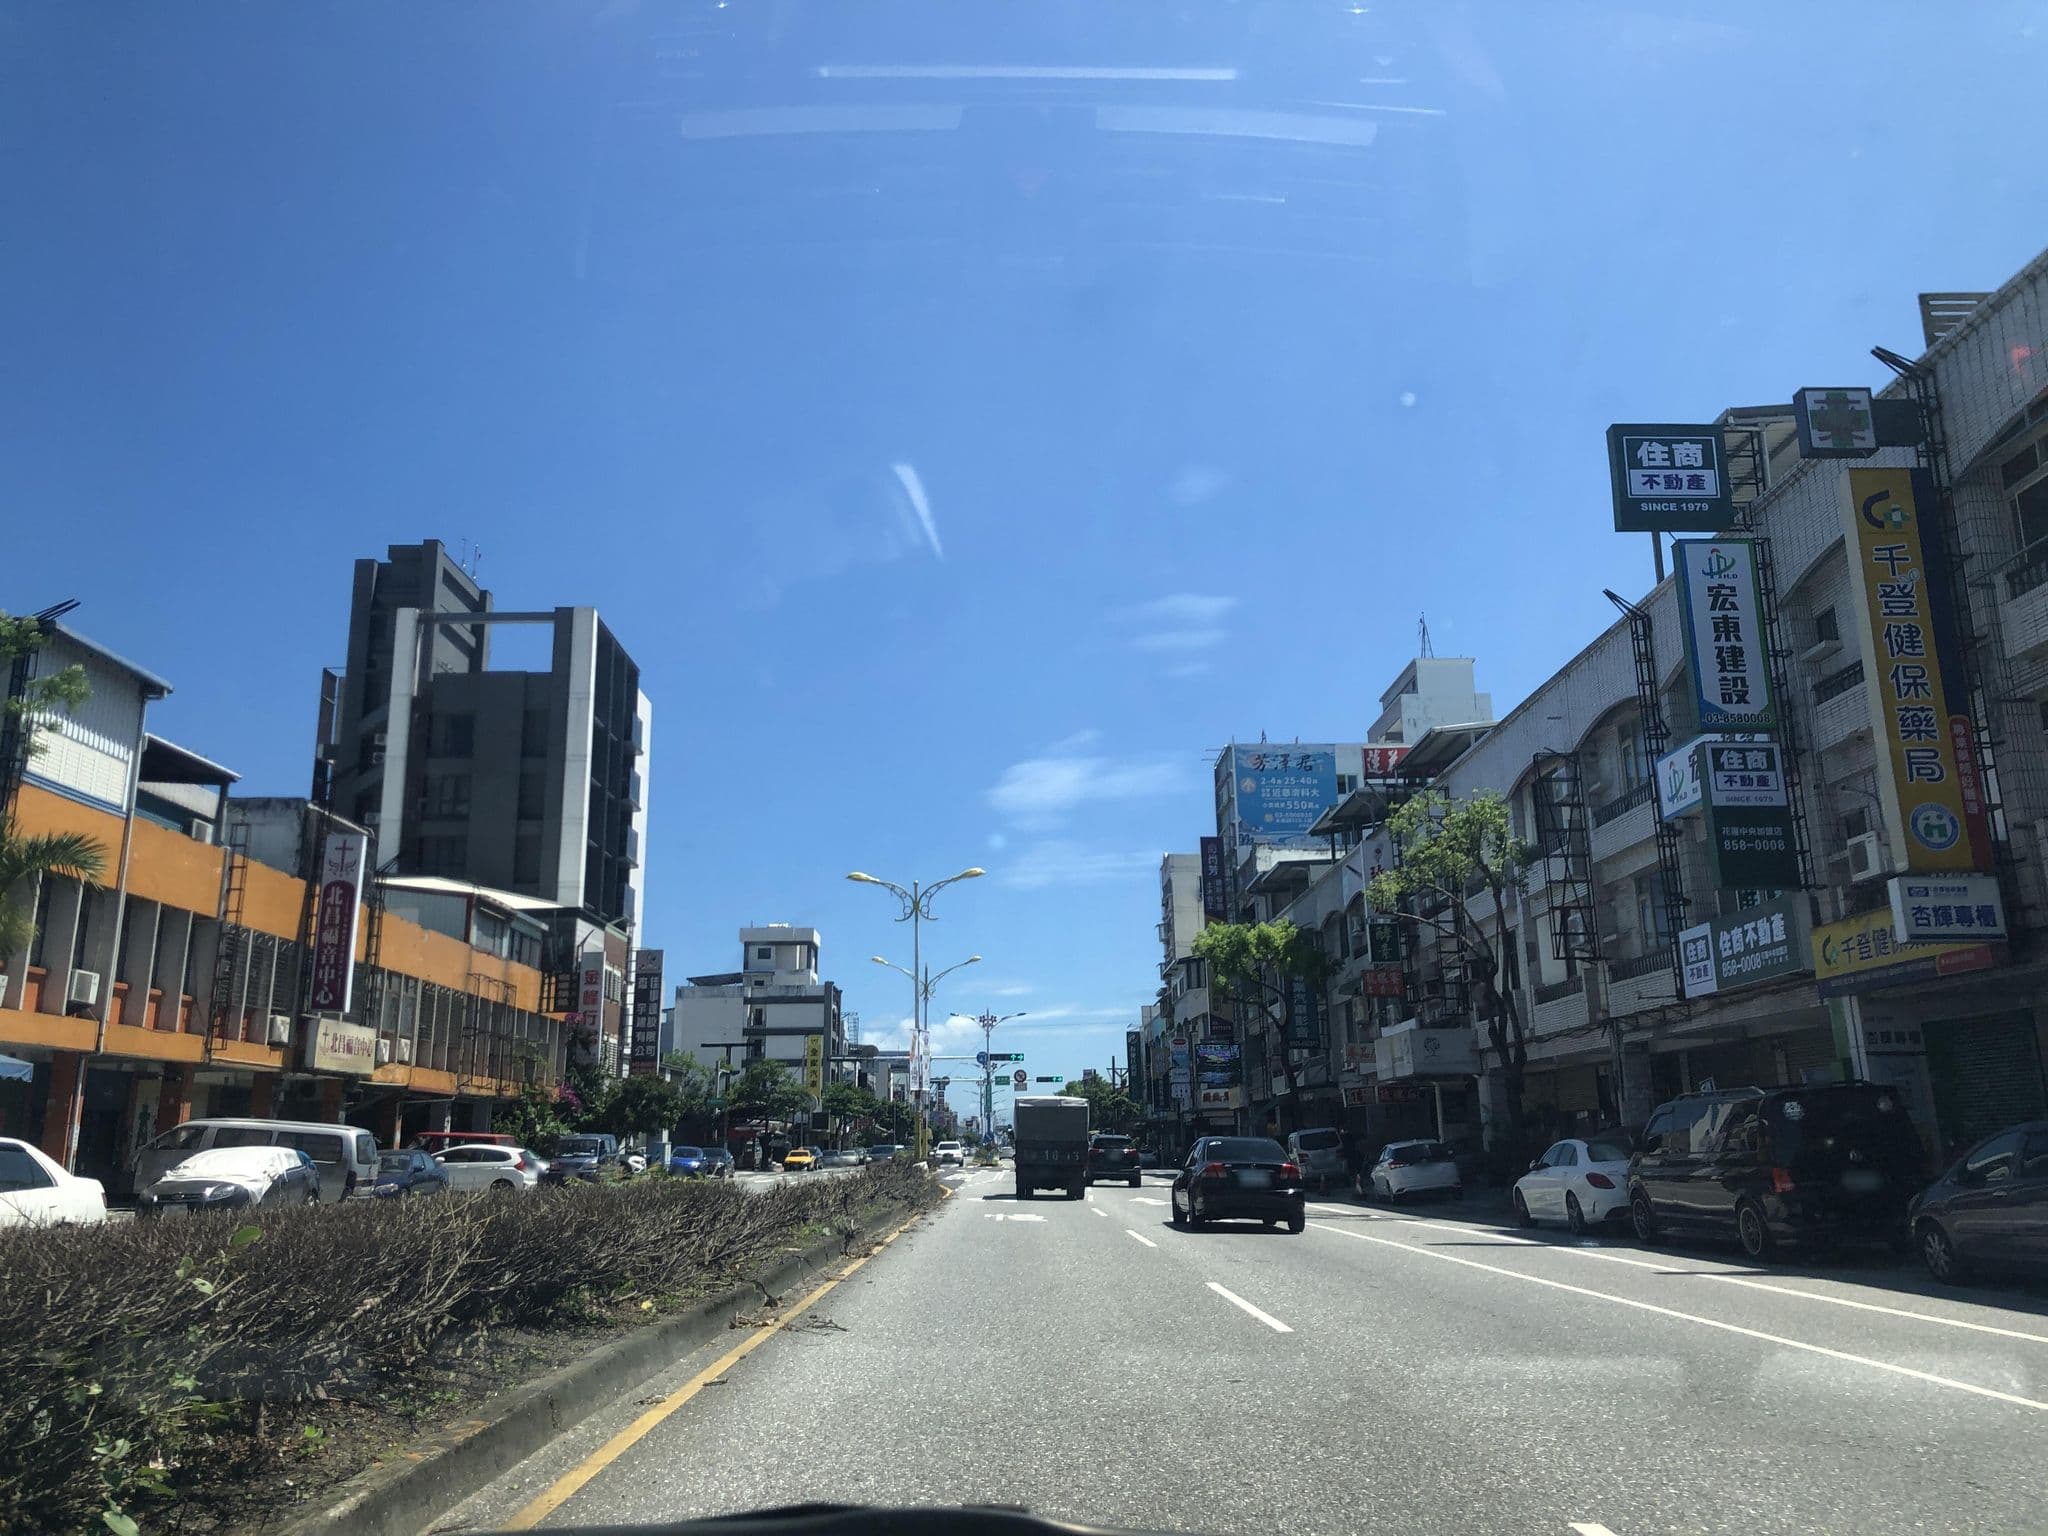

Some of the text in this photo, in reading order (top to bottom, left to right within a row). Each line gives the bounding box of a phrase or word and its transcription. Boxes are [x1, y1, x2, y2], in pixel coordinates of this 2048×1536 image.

[1637, 441, 1703, 468] 住商
[1641, 474, 1706, 491] 不動產
[1640, 502, 1709, 512] SINCE 1979
[1707, 583, 1751, 705] 宏東建設
[1873, 543, 1945, 784] 千登健保藥局
[1706, 712, 1771, 724] 03-8580008
[1720, 749, 1768, 770] 住商
[1723, 774, 1770, 787] 不動產
[1724, 839, 1786, 850] 858-0008
[1911, 904, 1998, 928] 杏輝專櫃
[316, 885, 345, 1005] 北昌福音中心
[1719, 912, 1787, 958] 住商不動產
[1686, 939, 1708, 963] 住商
[1722, 952, 1762, 978] 858-0008
[331, 1032, 373, 1057] 北昌福音中心
